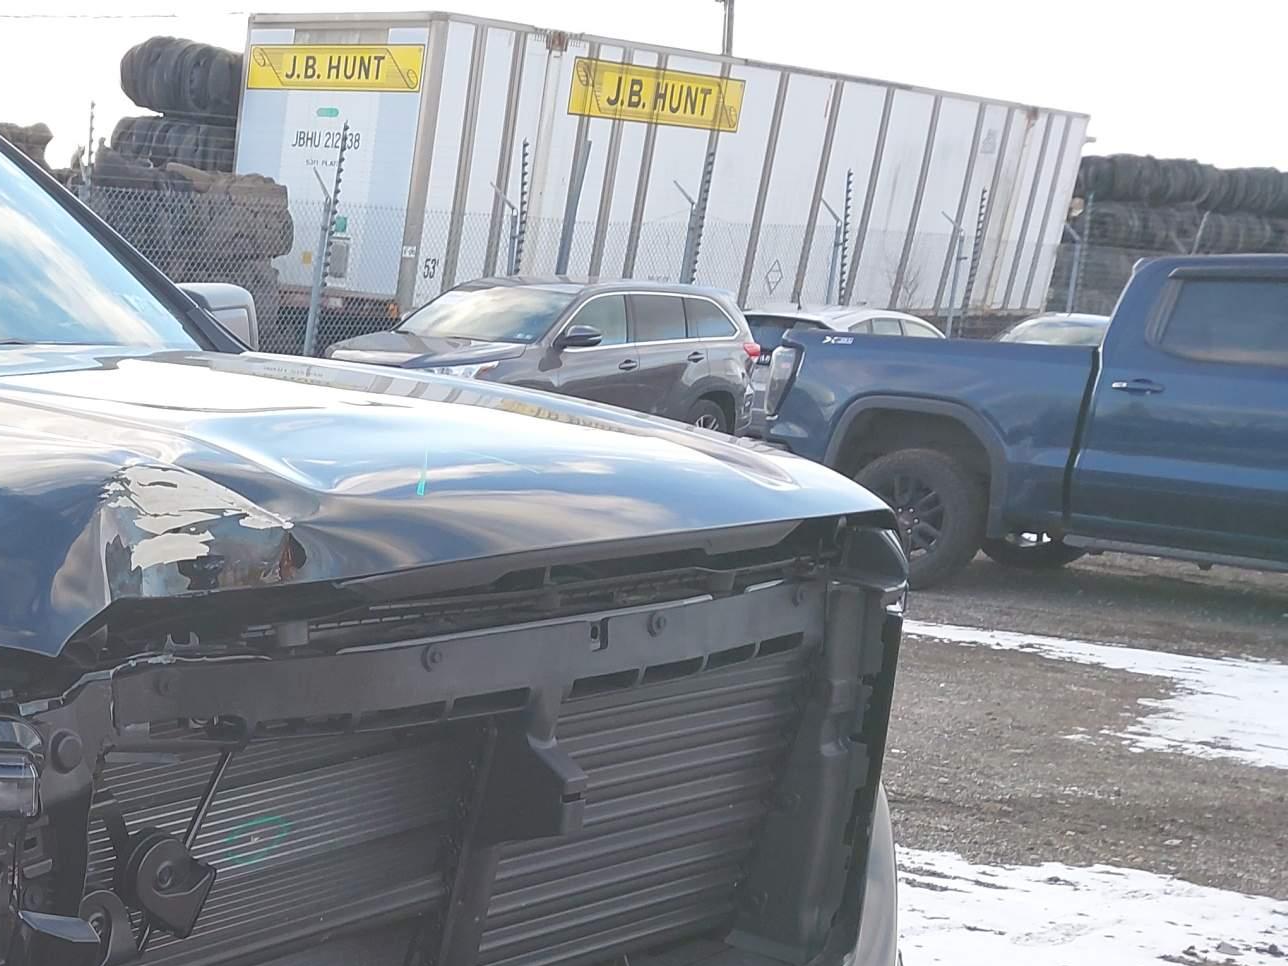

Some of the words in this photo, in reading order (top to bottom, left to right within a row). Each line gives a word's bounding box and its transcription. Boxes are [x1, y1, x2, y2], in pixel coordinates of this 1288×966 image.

[285, 55, 322, 80] J.B.
[326, 55, 386, 80] HUNT
[606, 76, 646, 109] J.B.
[653, 81, 713, 117] HUNT
[291, 131, 322, 148] JBHU
[323, 132, 361, 150] 21238
